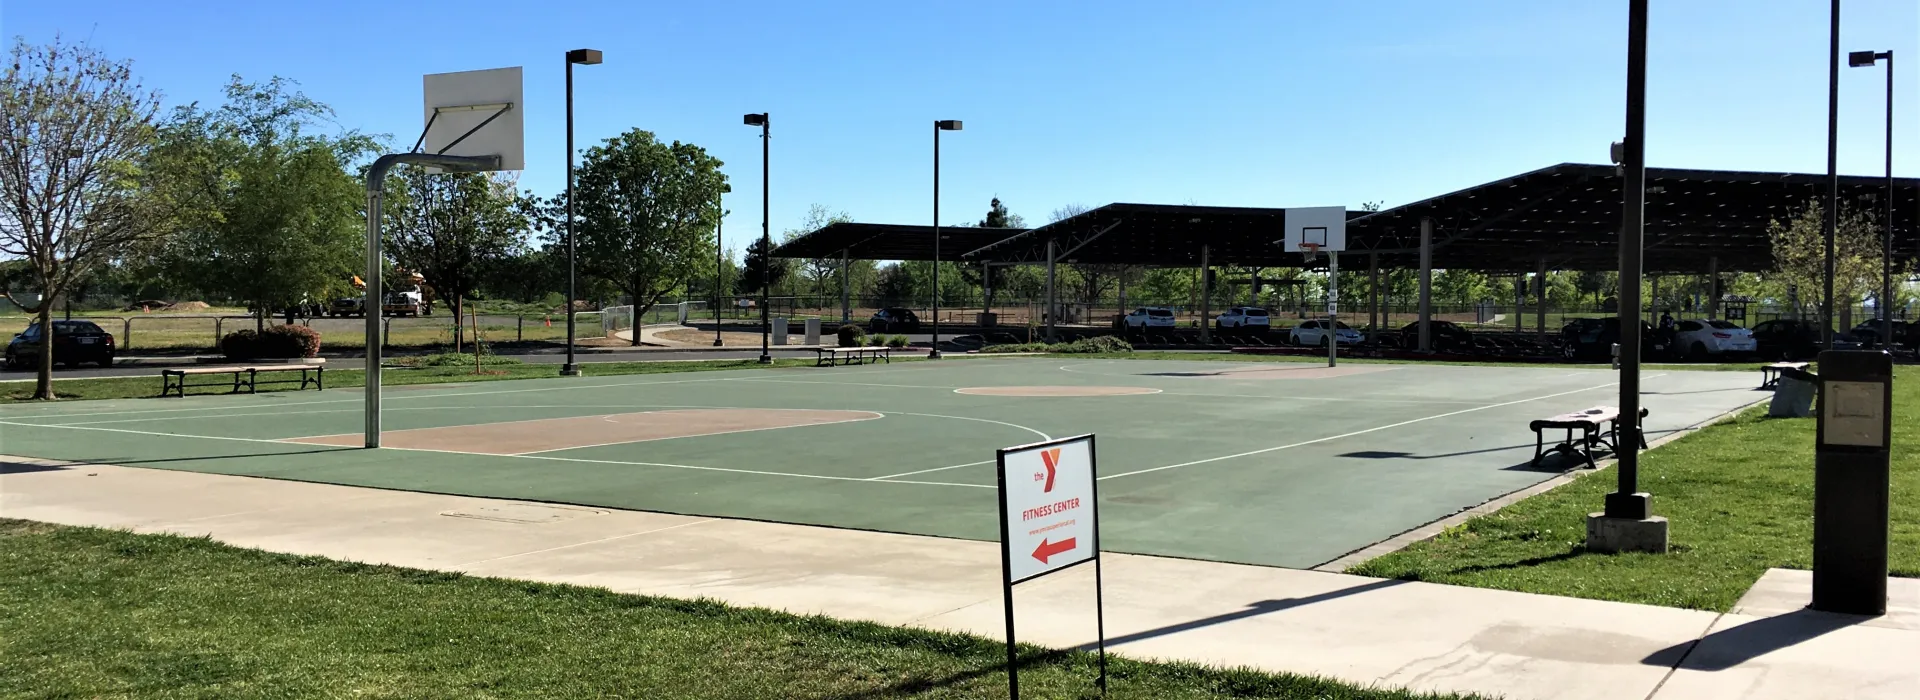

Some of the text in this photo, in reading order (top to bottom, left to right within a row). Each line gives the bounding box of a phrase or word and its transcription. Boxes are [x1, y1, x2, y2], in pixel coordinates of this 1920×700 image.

[1034, 448, 1060, 493] the Y
[1022, 497, 1080, 521] FITNESS CENTER
